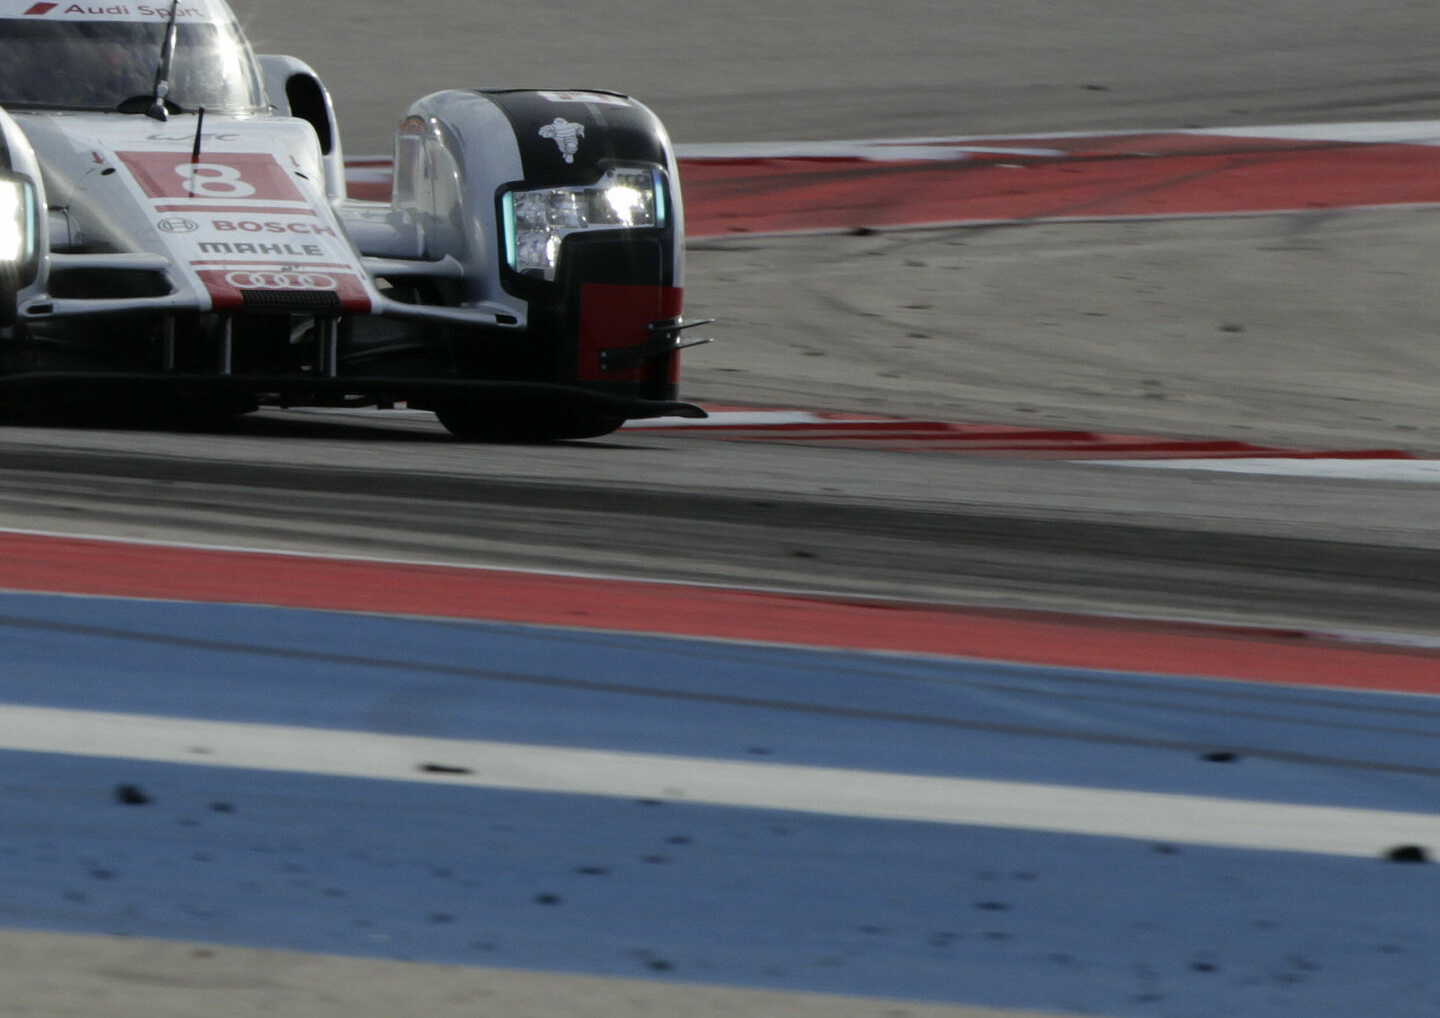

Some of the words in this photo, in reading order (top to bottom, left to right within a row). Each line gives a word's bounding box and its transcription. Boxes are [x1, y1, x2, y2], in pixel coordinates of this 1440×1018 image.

[64, 3, 129, 15] Audi
[174, 162, 257, 199] 8
[212, 220, 337, 238] BOSCH
[198, 242, 324, 257] MAHLE
